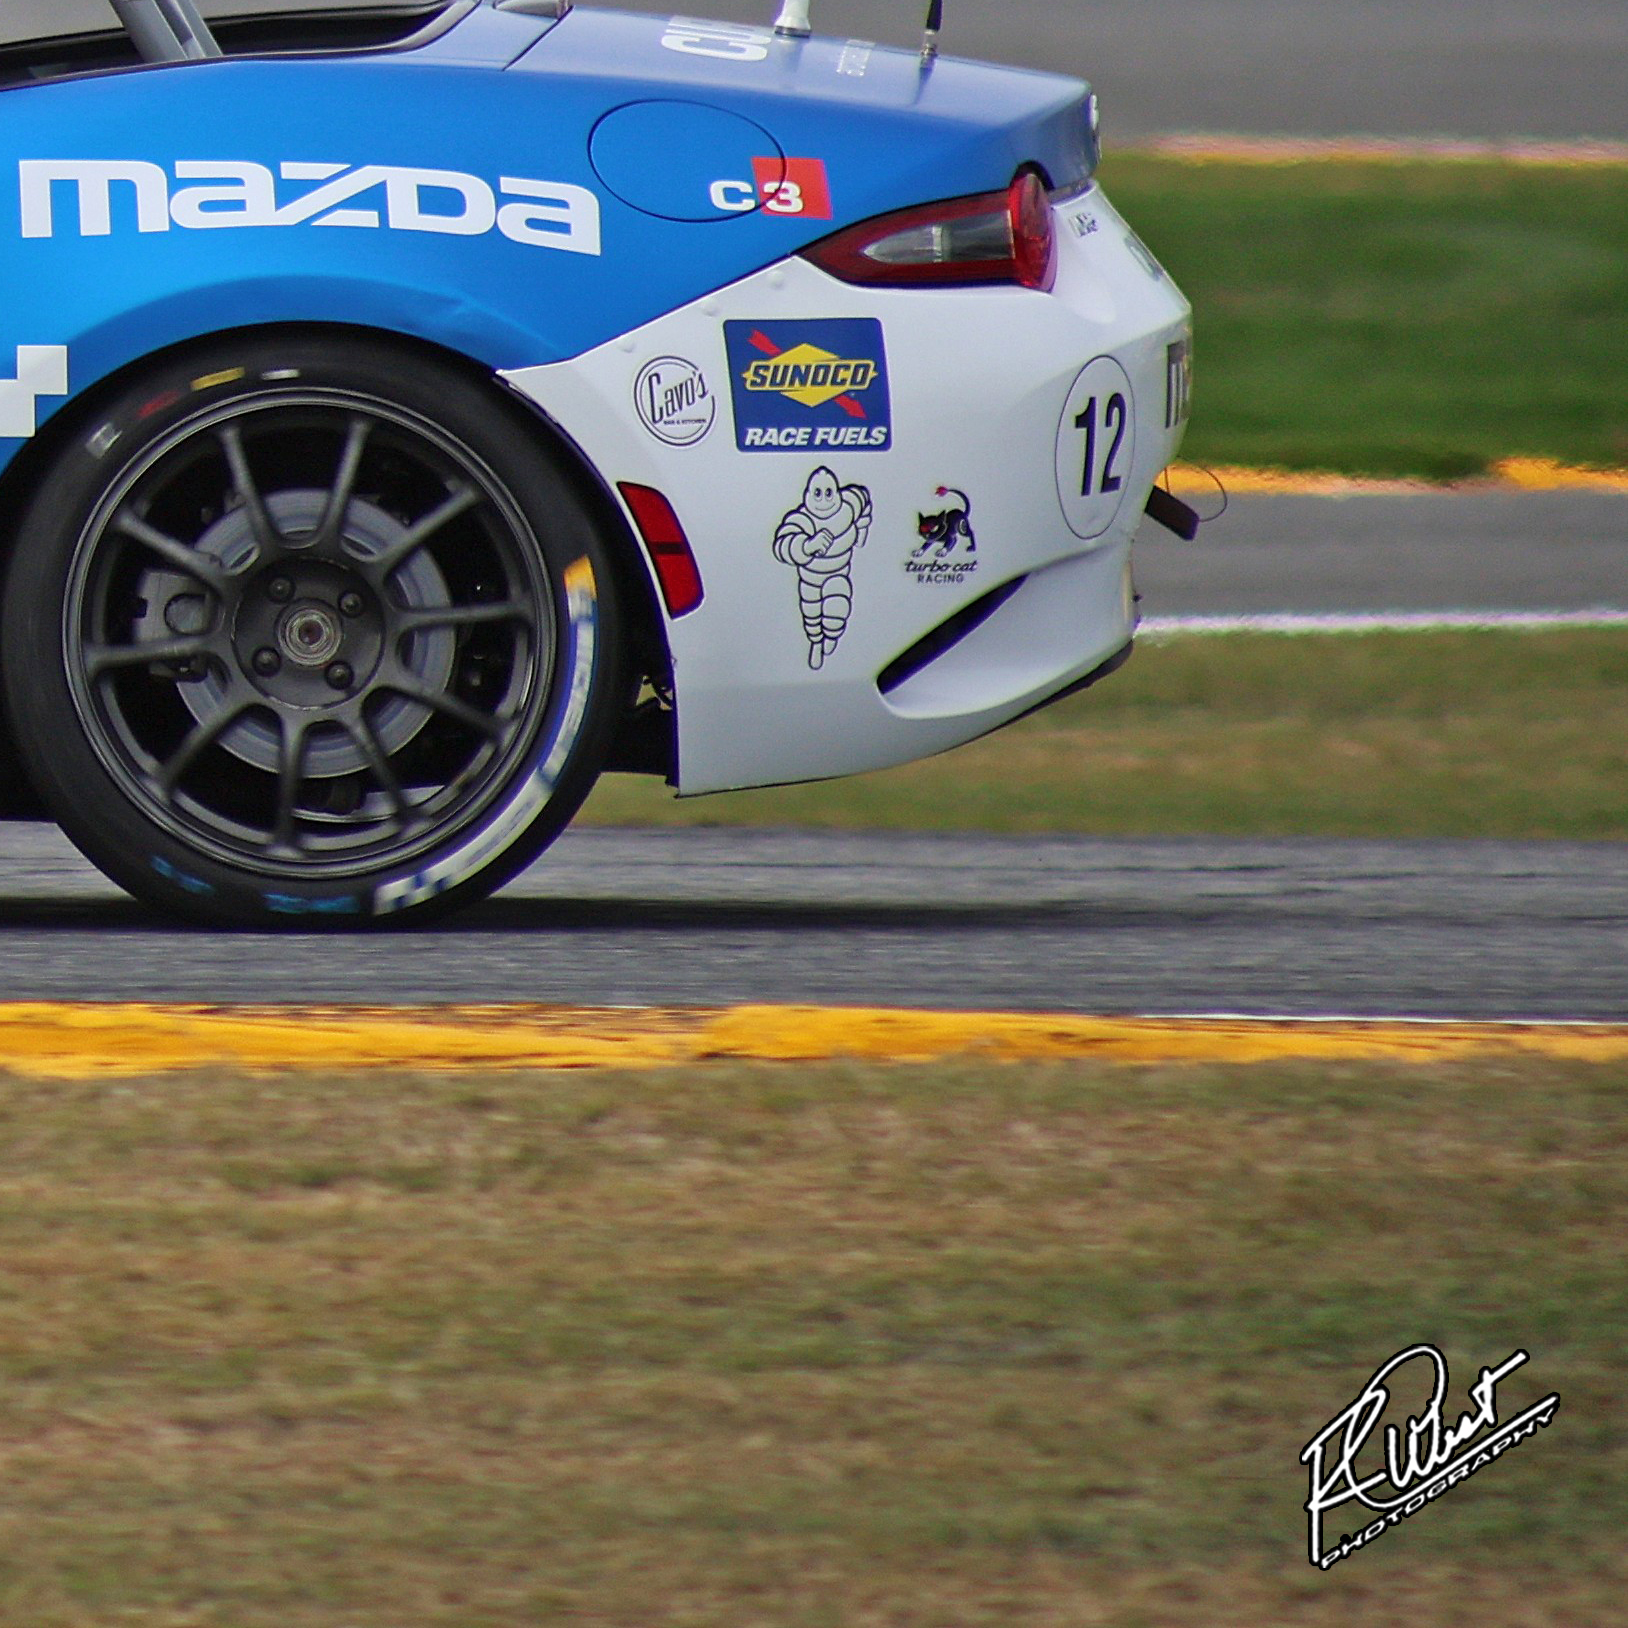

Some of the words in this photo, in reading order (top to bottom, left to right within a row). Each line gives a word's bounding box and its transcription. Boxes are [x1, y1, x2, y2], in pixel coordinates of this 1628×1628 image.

[709, 179, 804, 213] C3
[749, 362, 873, 388] SUNOCO
[745, 427, 810, 447] RACE
[813, 426, 887, 446] FUELS
[1075, 392, 1127, 497] 12
[904, 559, 950, 573] turbo
[952, 559, 978, 572] cat
[917, 573, 964, 583] RACING
